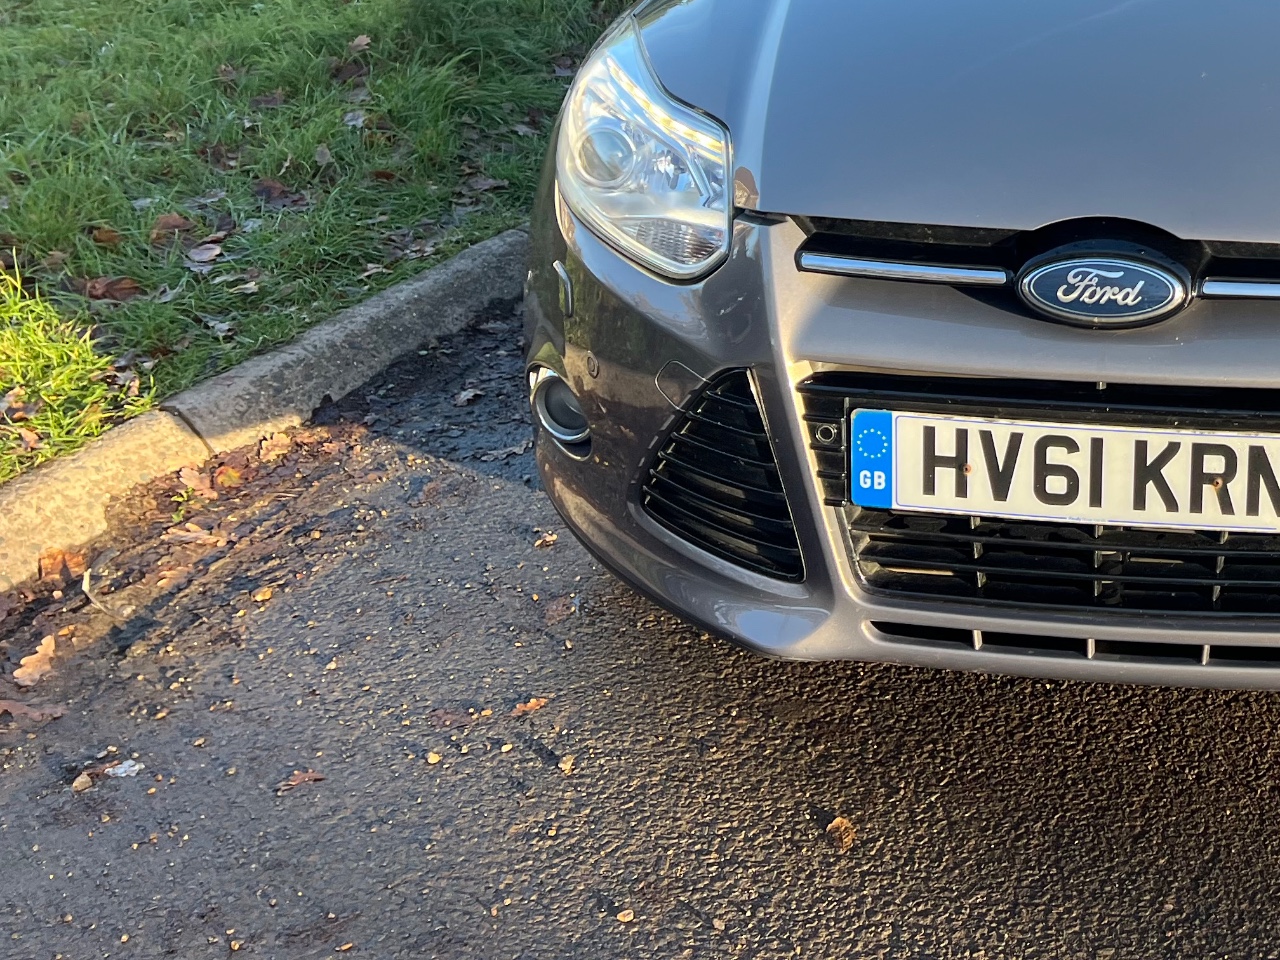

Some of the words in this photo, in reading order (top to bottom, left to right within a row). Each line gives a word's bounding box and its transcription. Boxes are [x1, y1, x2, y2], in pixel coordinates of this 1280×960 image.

[1055, 267, 1147, 308] Ford
[859, 469, 886, 490] GB
[921, 424, 1104, 508] HV61
